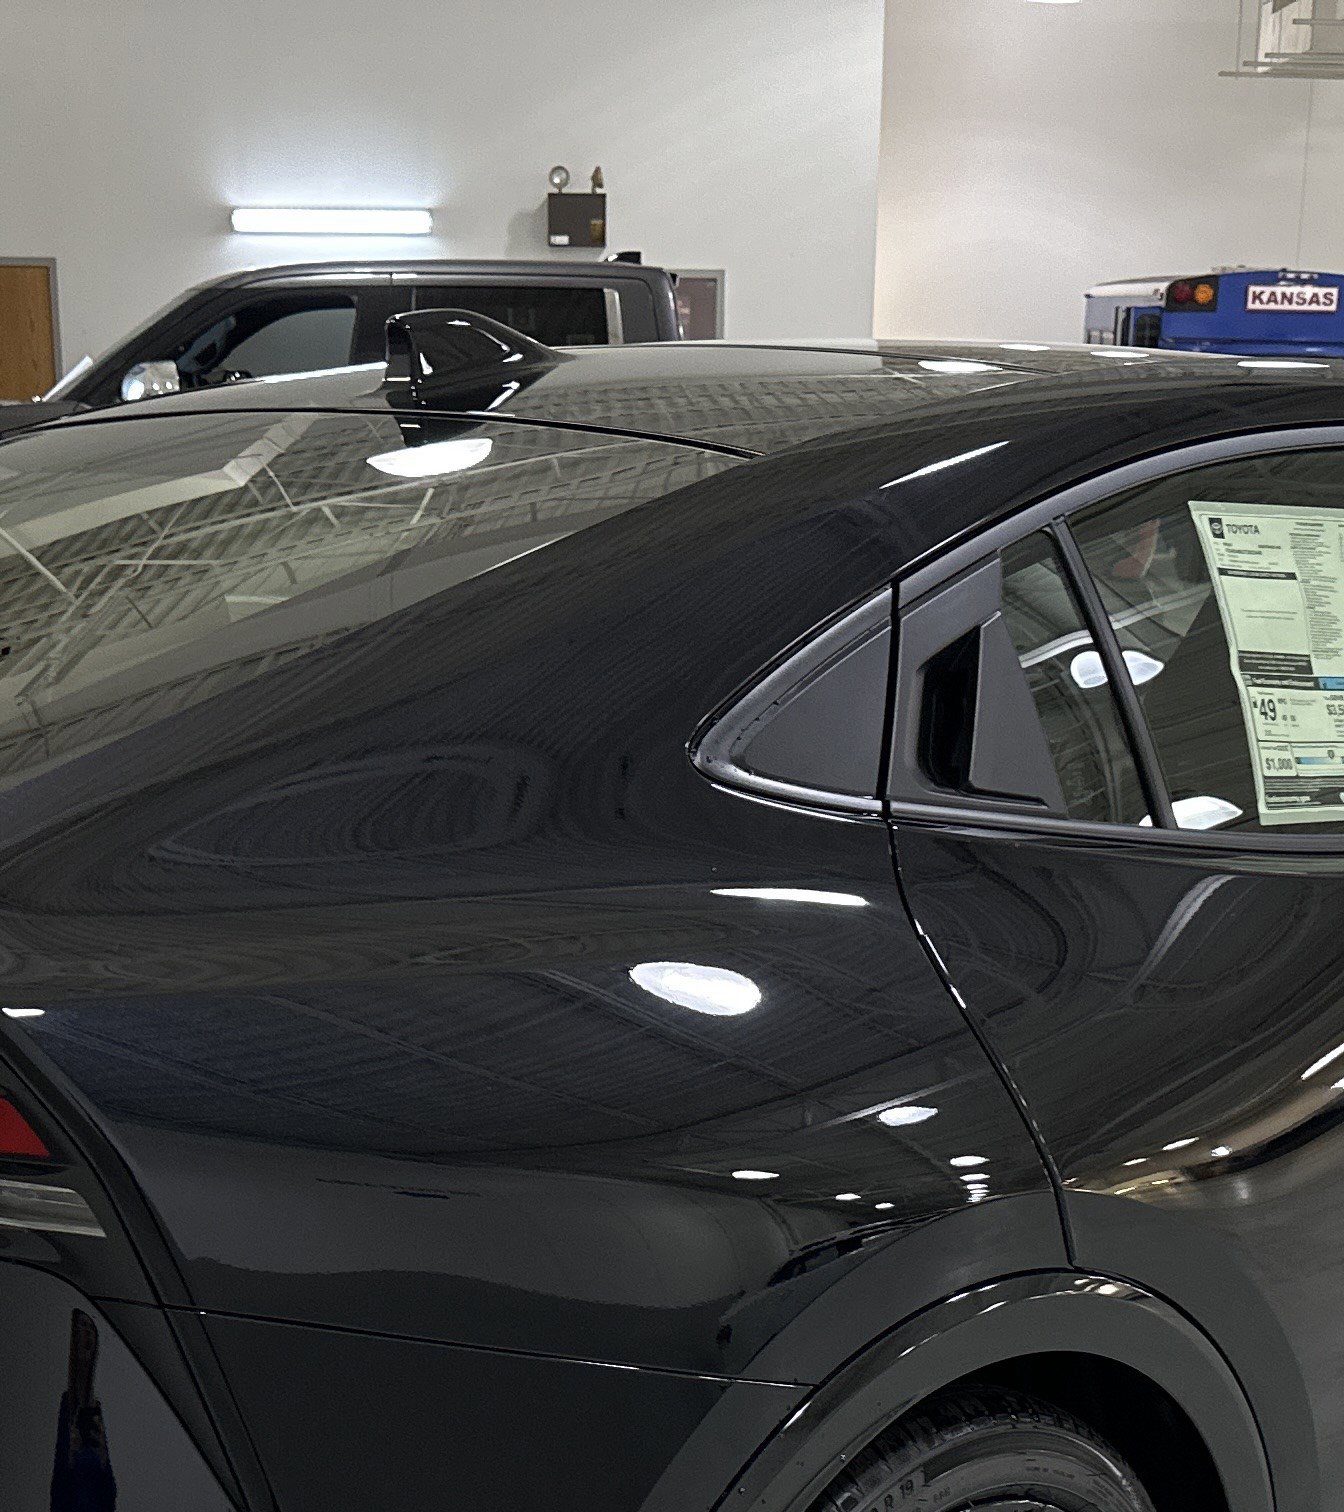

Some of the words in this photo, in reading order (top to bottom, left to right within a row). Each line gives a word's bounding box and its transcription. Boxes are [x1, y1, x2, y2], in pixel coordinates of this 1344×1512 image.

[1250, 289, 1335, 307] KANSAS
[1225, 522, 1261, 536] TOYOTA
[1258, 698, 1277, 722] 49
